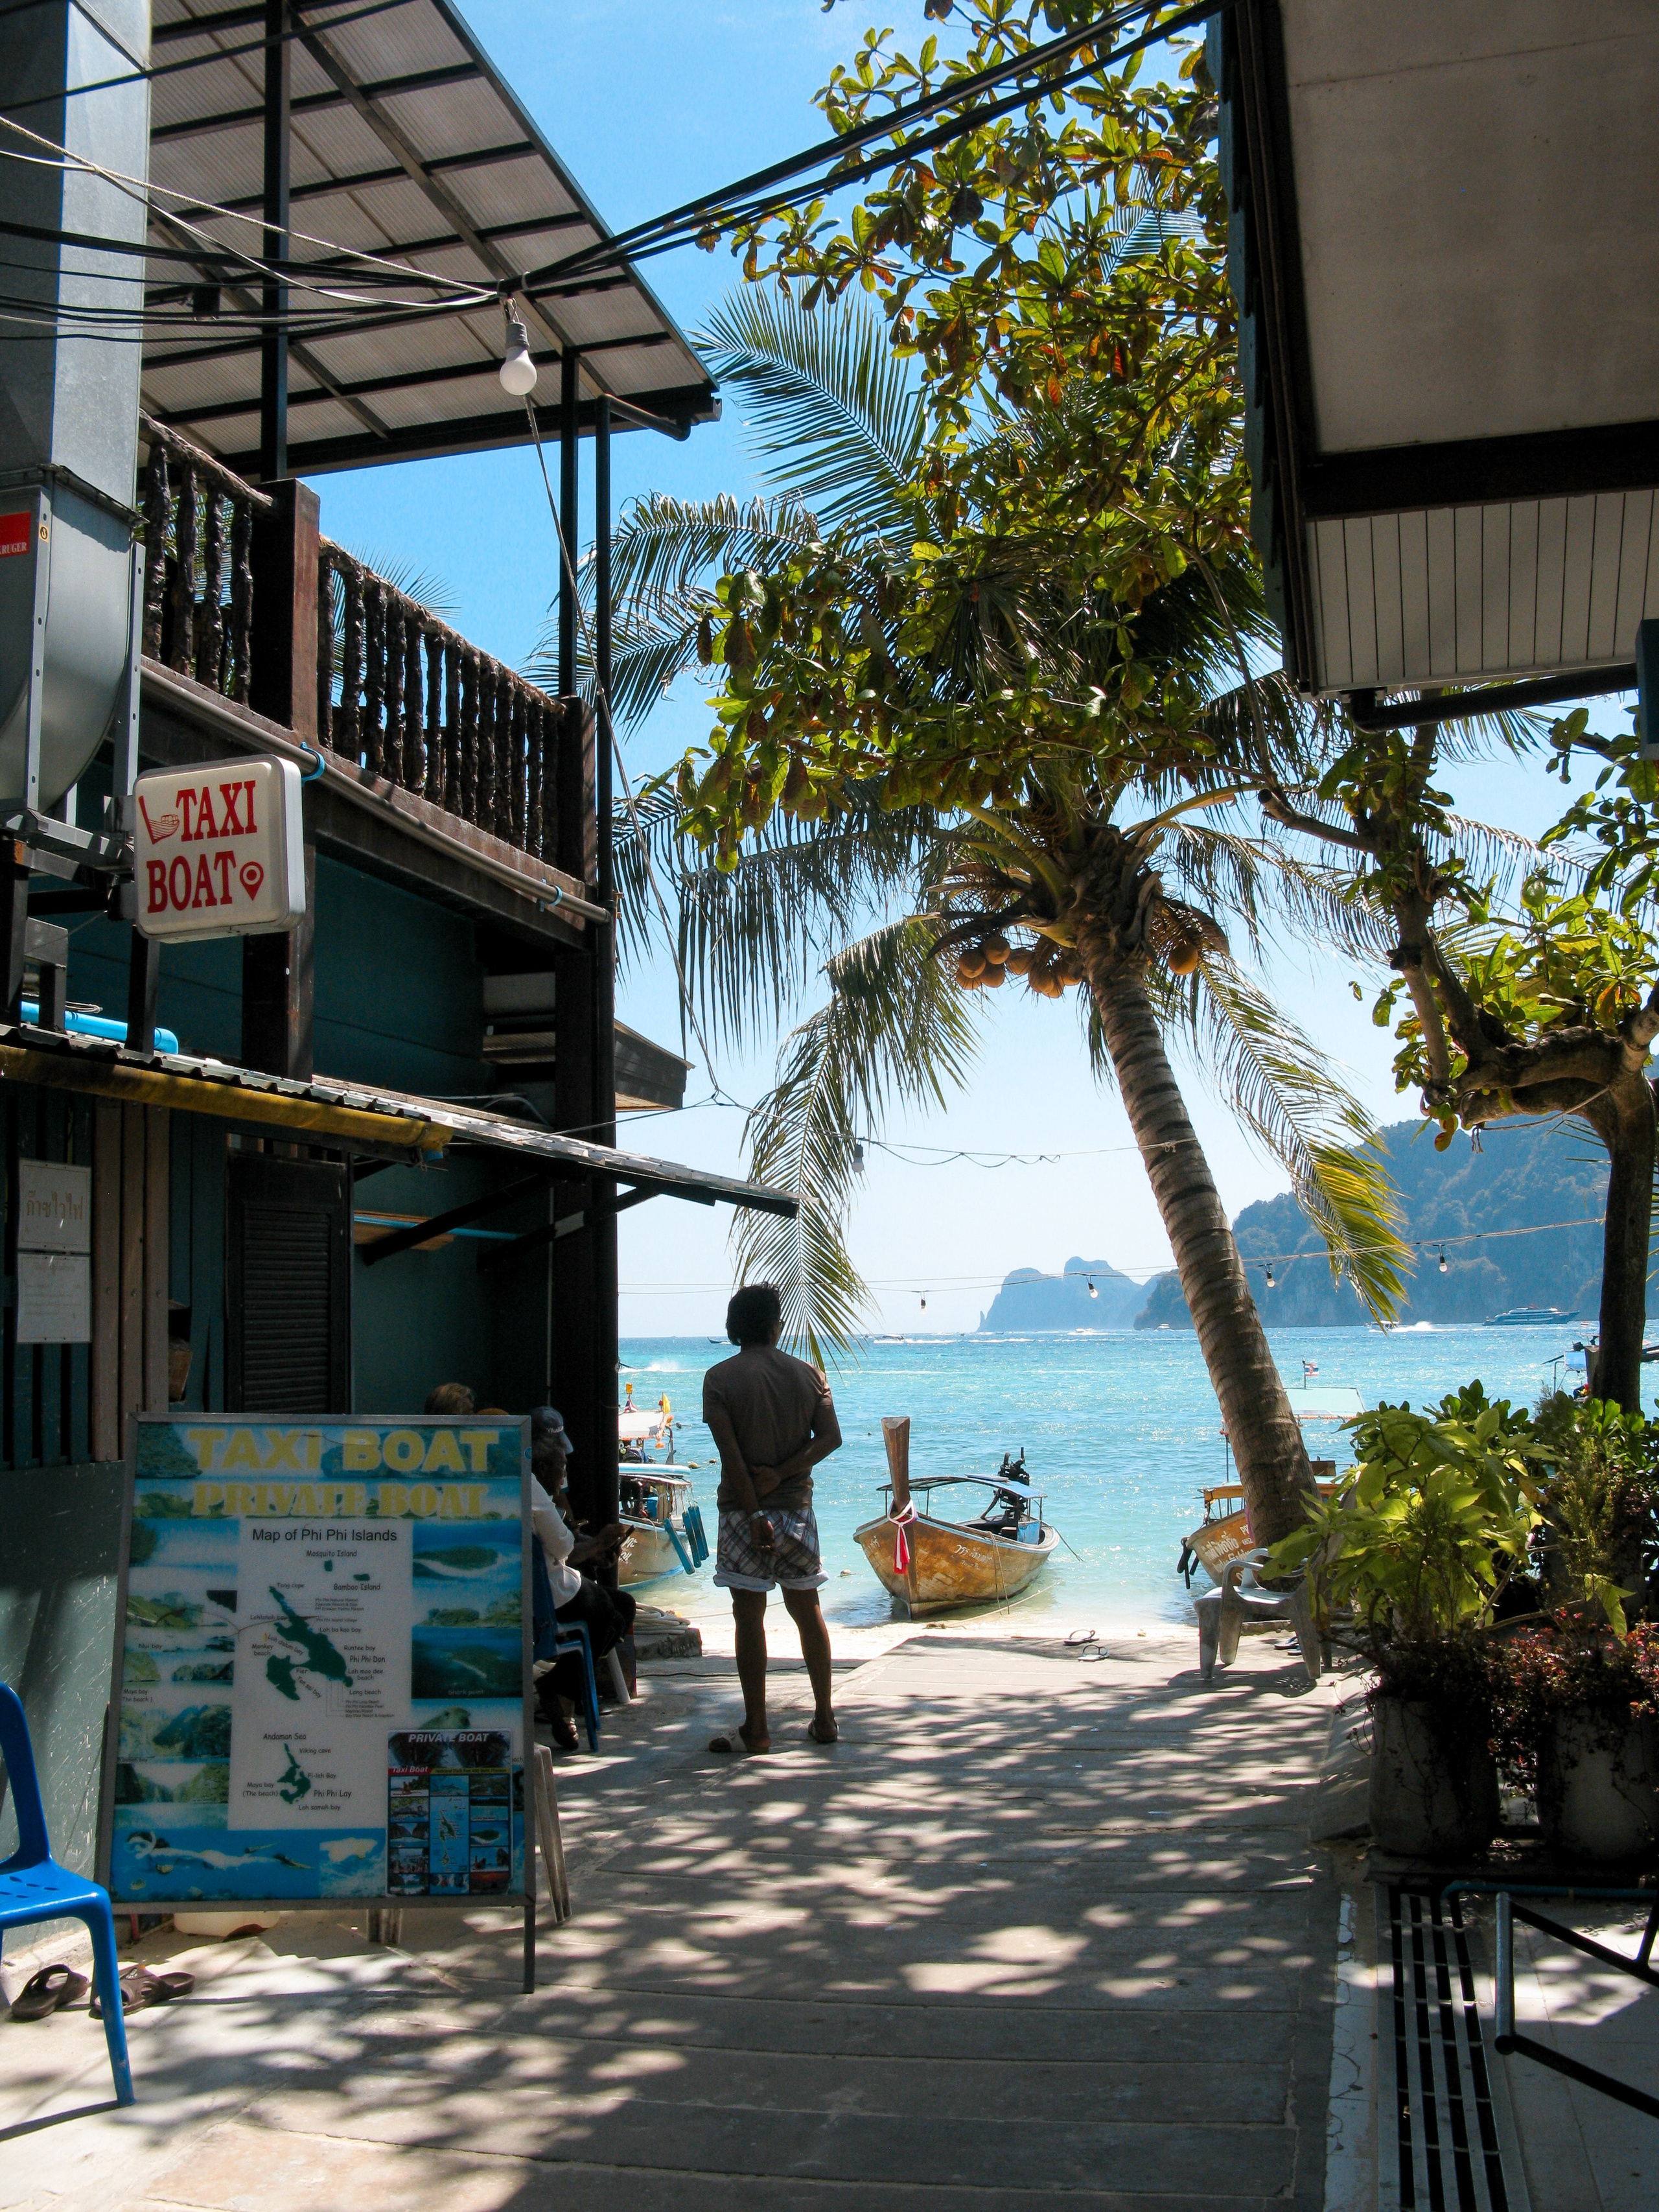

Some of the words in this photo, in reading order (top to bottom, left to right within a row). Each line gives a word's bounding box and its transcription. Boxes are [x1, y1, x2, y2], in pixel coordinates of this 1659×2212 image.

[0, 542, 27, 555] RUGER
[176, 780, 258, 842] TAXI
[146, 850, 237, 914] BOAT
[188, 1428, 323, 1470] TAXI
[342, 1430, 500, 1472] BOAT
[192, 1482, 368, 1517] PRIVATE
[378, 1482, 489, 1517] BOAT
[252, 1528, 281, 1543] Map
[284, 1528, 298, 1541] of
[301, 1528, 322, 1541] Phi
[326, 1528, 347, 1541] Phi
[351, 1528, 398, 1542] Islands
[306, 1550, 336, 1558] Mosquito
[267, 1634, 279, 1643] Loh
[293, 1646, 304, 1657] bay
[312, 1686, 322, 1698] bay
[408, 1733, 456, 1743] PRIVATE
[458, 1733, 491, 1743] BOAT
[339, 1789, 352, 1799] Lay
